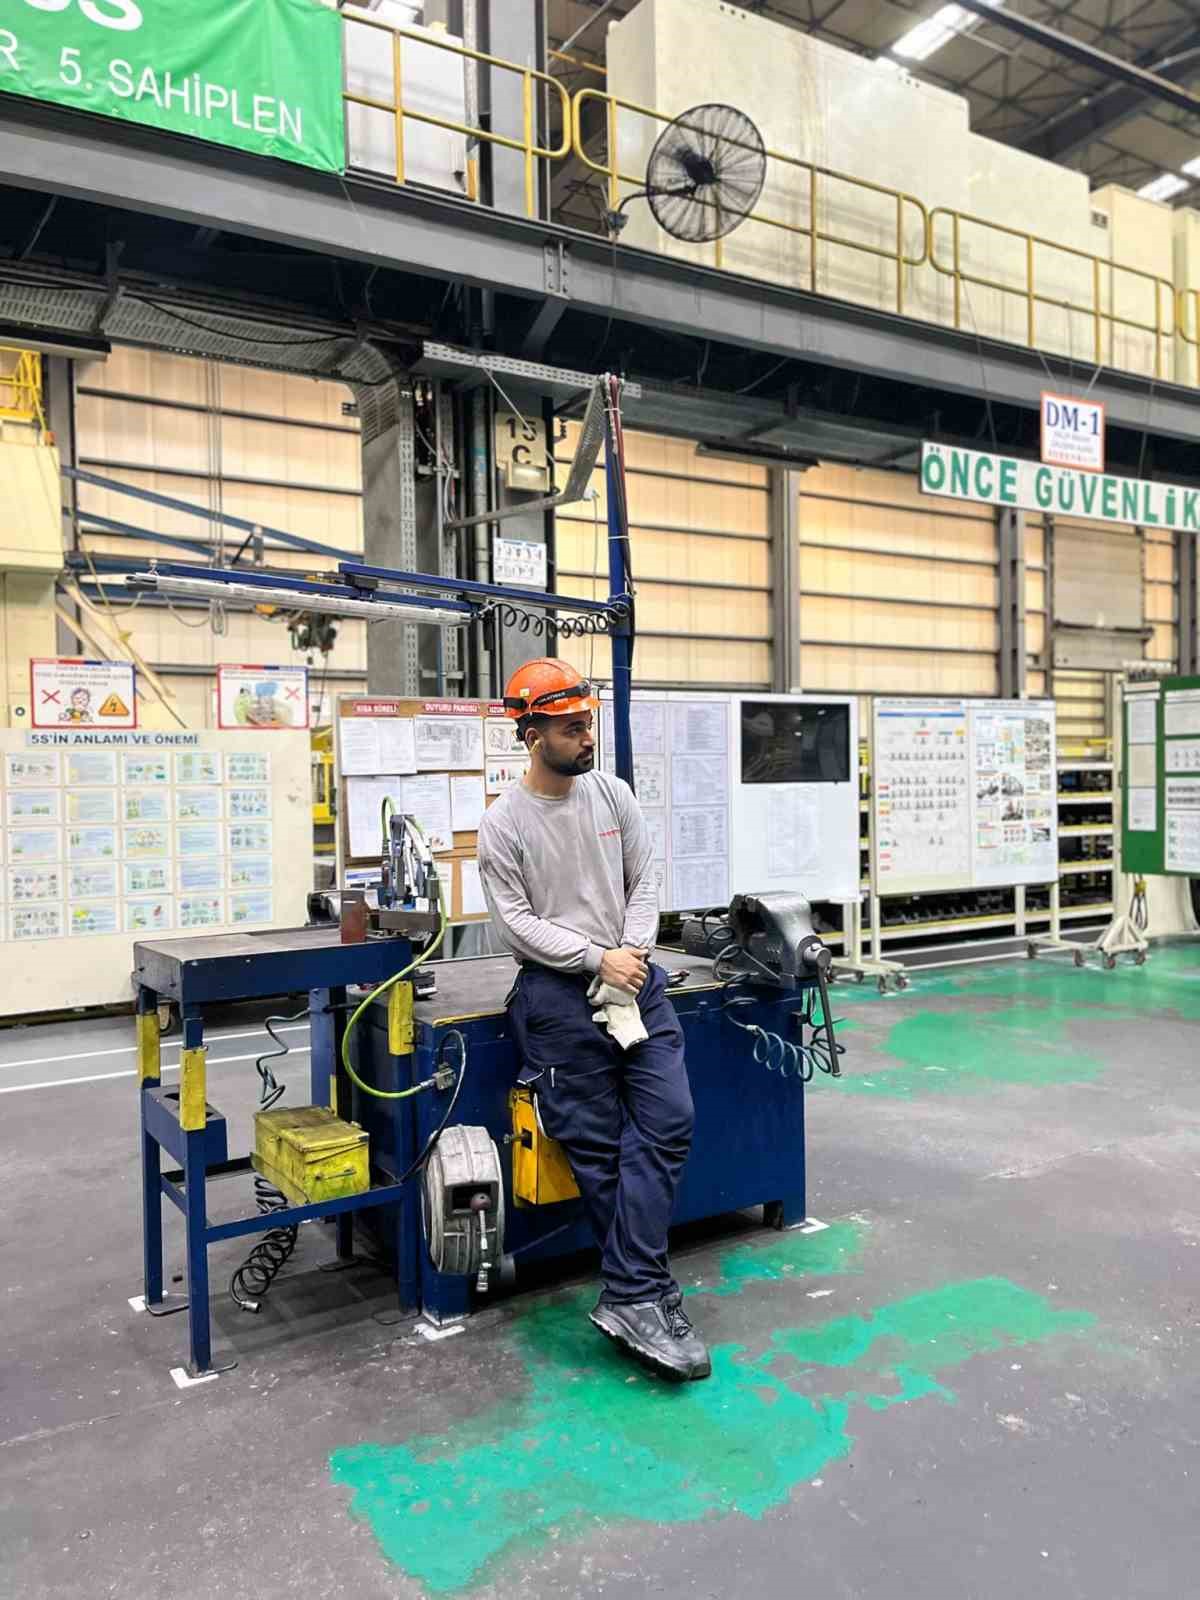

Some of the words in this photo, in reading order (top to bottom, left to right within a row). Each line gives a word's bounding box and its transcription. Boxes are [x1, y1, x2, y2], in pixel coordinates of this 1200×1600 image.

[0, 28, 20, 71] R
[59, 48, 93, 90] 5.
[108, 59, 303, 144] SAHİPLEN
[1045, 400, 1099, 435] DM-1
[923, 445, 1017, 502] ÖNCE
[1035, 466, 1200, 530] GÜVENLİK
[31, 732, 69, 744] 5S'İN
[73, 734, 128, 744] ANLAMI
[132, 734, 151, 744] VE
[154, 732, 198, 745] ÖNEMİ
